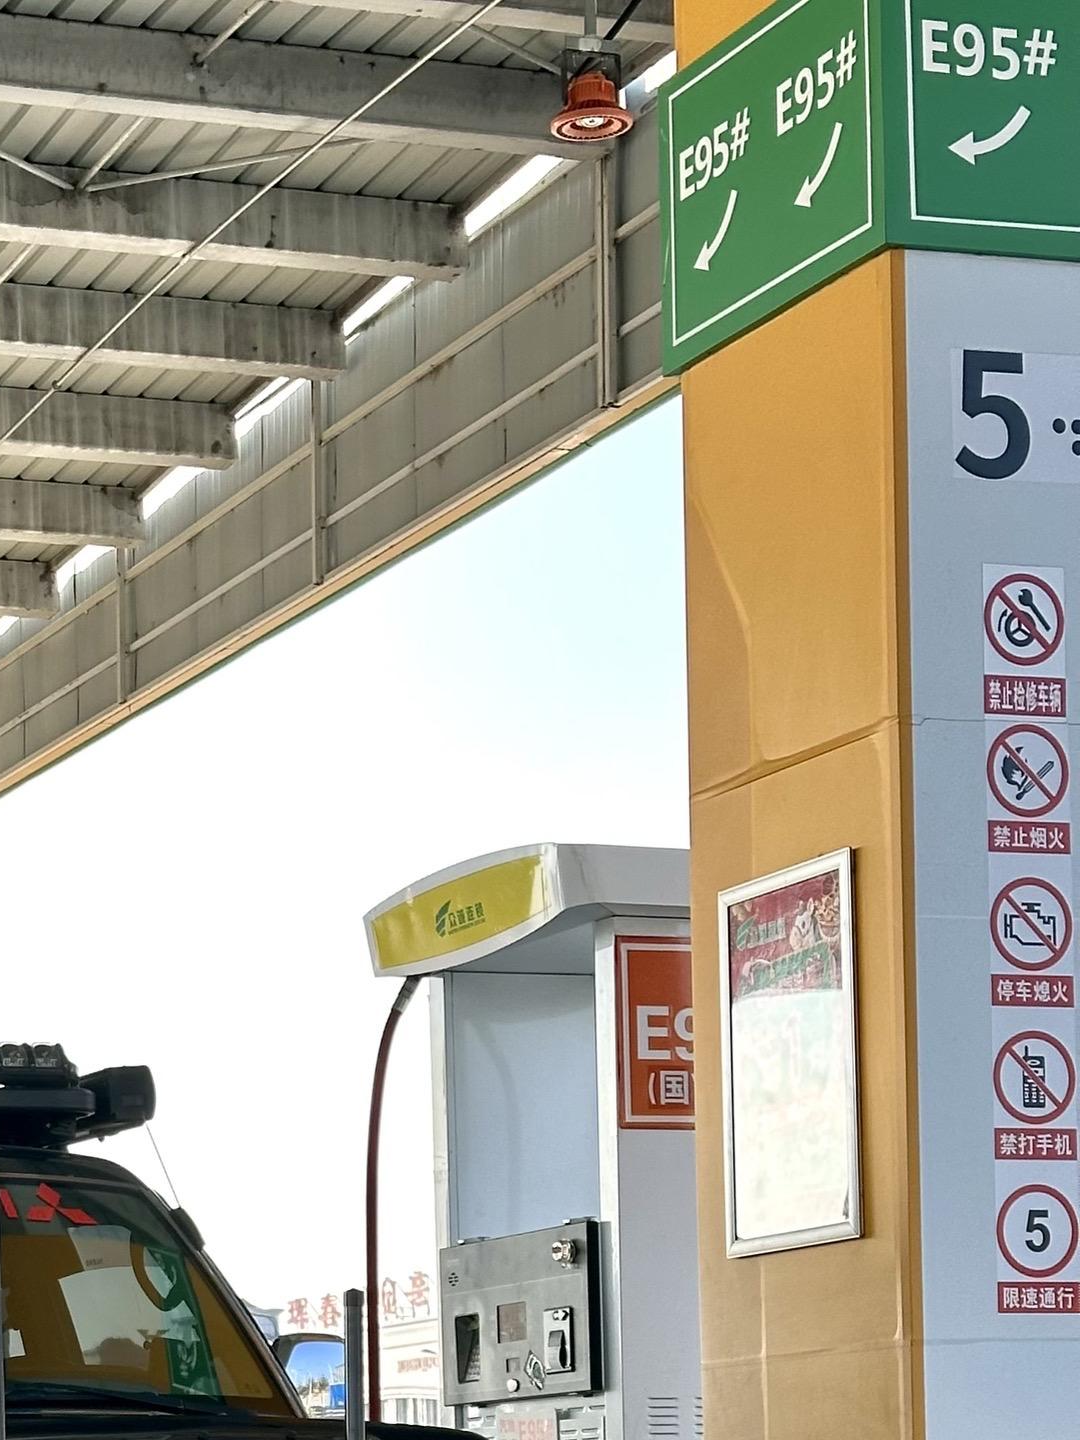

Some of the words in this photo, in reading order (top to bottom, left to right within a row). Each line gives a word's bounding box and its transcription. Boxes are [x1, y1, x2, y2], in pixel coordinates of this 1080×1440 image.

[921, 19, 1058, 81] E95#
[775, 29, 857, 138] E95#
[678, 106, 751, 202] E95#
[954, 349, 1030, 480] 5
[988, 680, 1062, 713] 禁止检修车辆
[993, 825, 1065, 850] 禁止烟火
[997, 979, 1069, 1003] 停车熄火
[999, 1133, 1073, 1156] 禁打手机
[1025, 1209, 1051, 1253] 5
[1003, 1287, 1075, 1310] 限速通行
